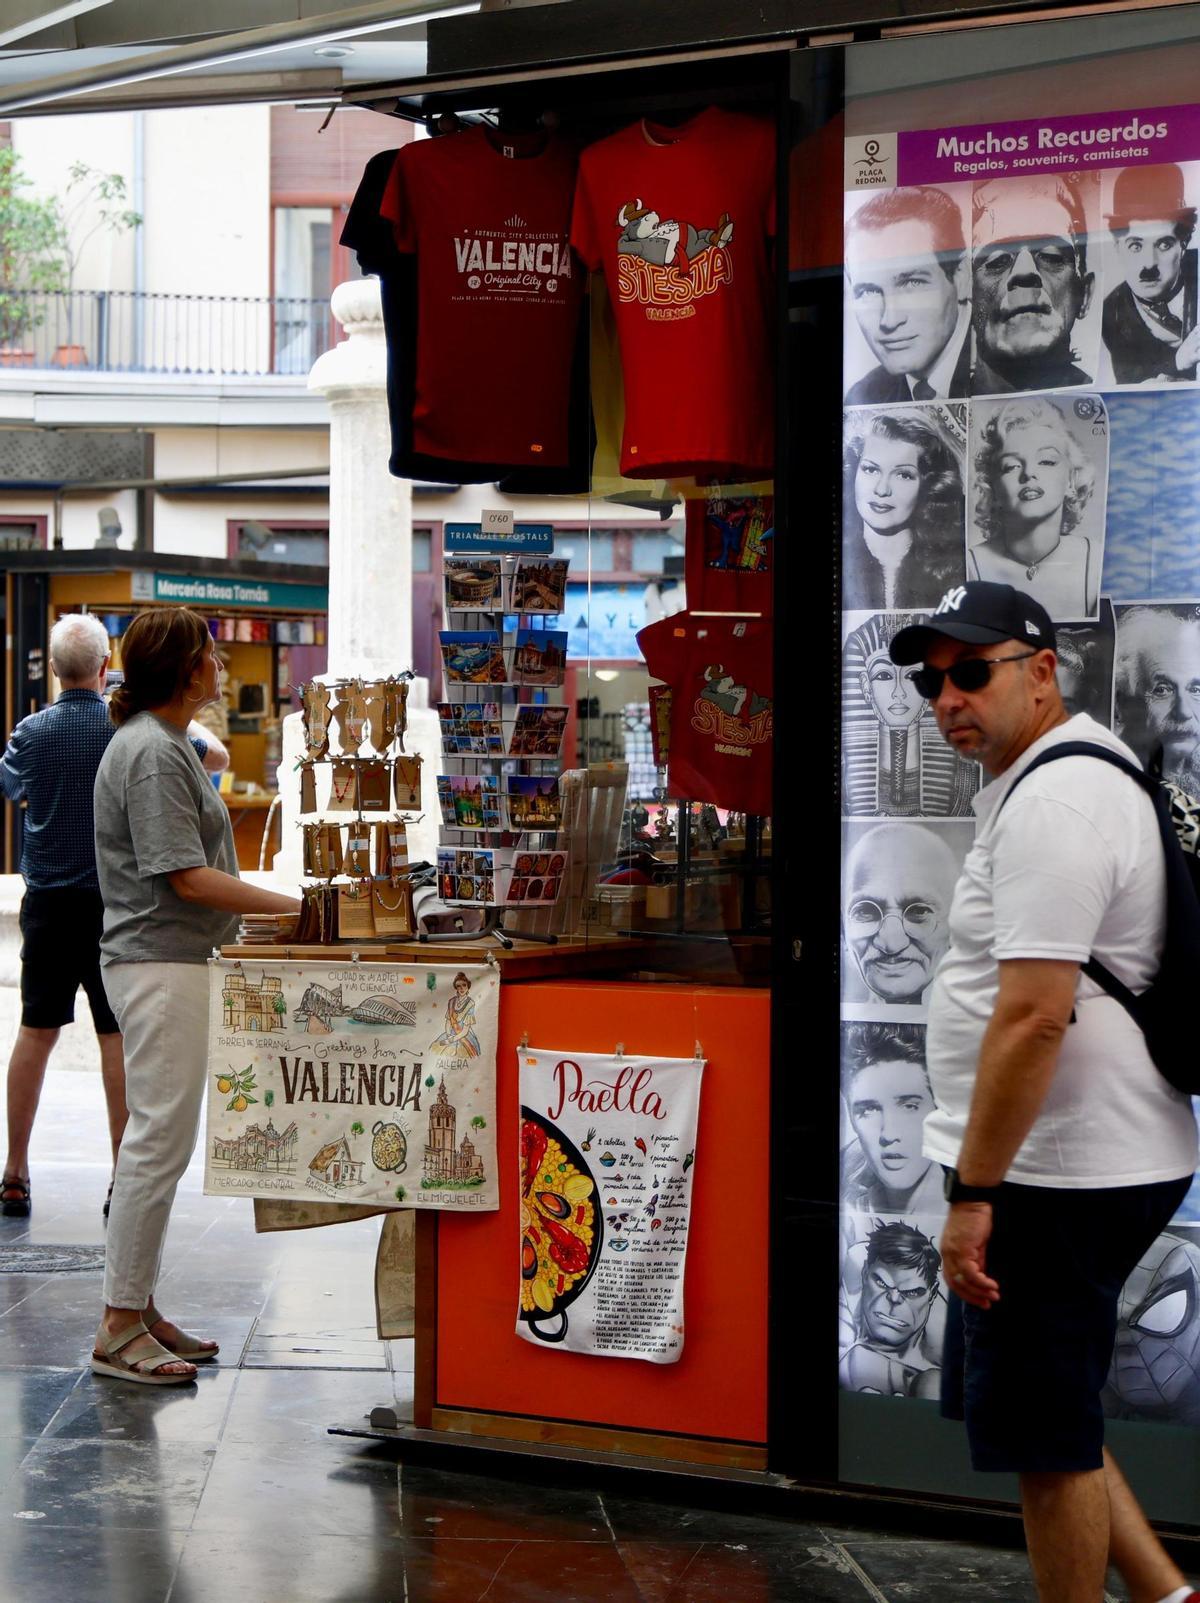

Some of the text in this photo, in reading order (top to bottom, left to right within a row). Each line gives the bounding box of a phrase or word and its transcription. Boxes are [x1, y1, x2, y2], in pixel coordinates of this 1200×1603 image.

[936, 117, 1168, 158] Muchos Recuerdos
[953, 145, 1149, 175] Regalos, souvenirs, camisetas
[855, 176, 887, 185] REDONA
[454, 237, 572, 279] VALENCIA
[484, 272, 543, 291] Original City
[506, 533, 549, 543] POSTALS
[206, 583, 233, 600] Rosa
[232, 585, 270, 603] Tomás
[314, 1038, 397, 1059] Greetings from
[279, 1056, 423, 1111] VALENCIA
[548, 1060, 667, 1120] Paella
[213, 1177, 295, 1191] MERCADO CENTRAL
[417, 1192, 428, 1202] EL
